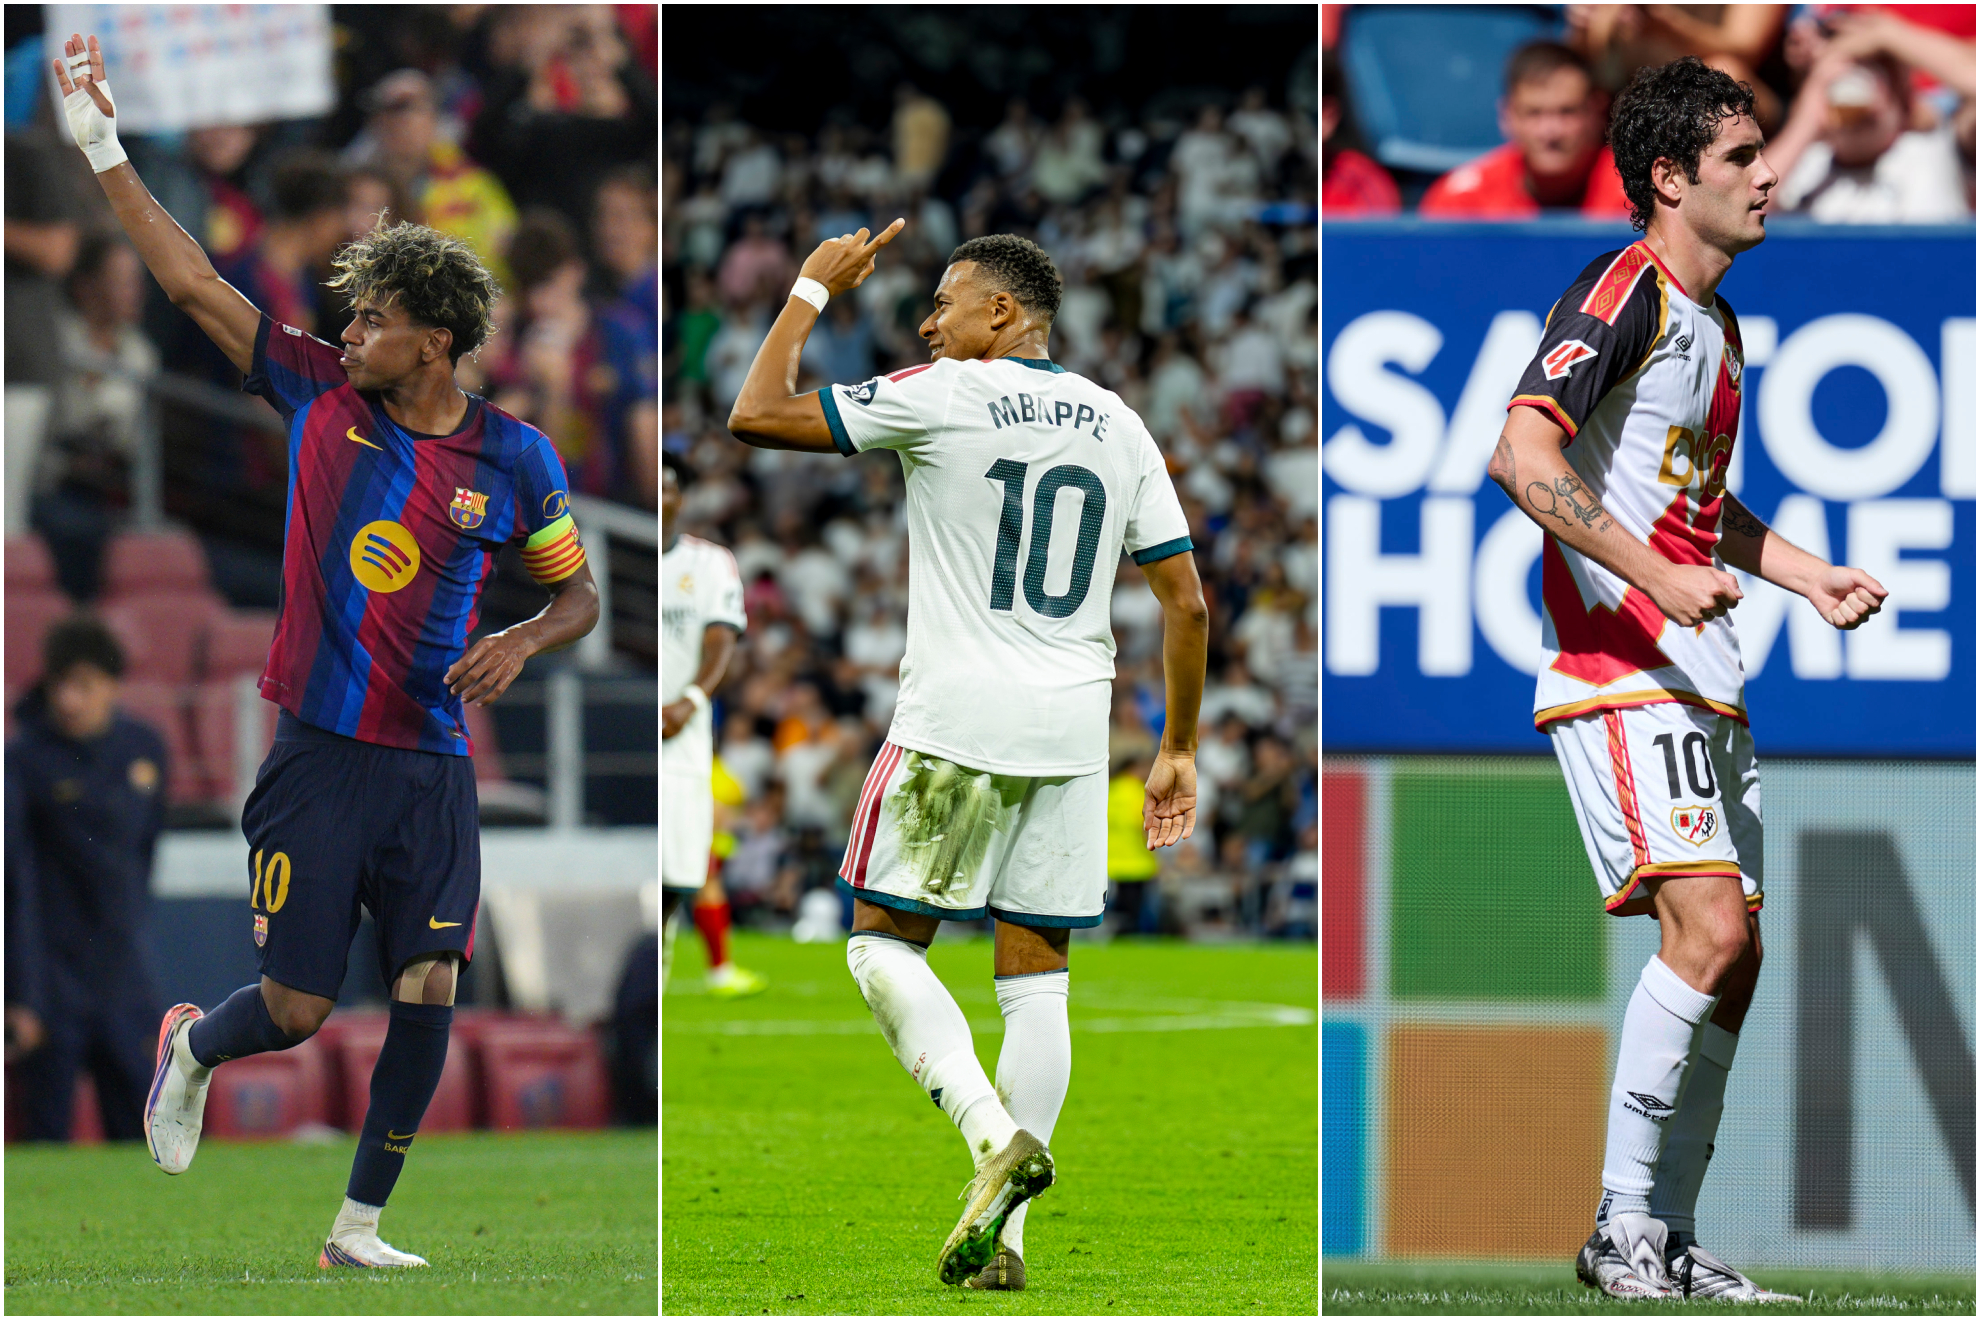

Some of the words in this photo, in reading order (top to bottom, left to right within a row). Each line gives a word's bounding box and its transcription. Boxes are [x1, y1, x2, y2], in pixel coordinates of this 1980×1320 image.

[987, 392, 1111, 443] MBAPPÉ
[983, 457, 1107, 618] 10
[1652, 731, 1716, 800] 10
[251, 848, 291, 914] 10
[1623, 1101, 1669, 1122] umbro
